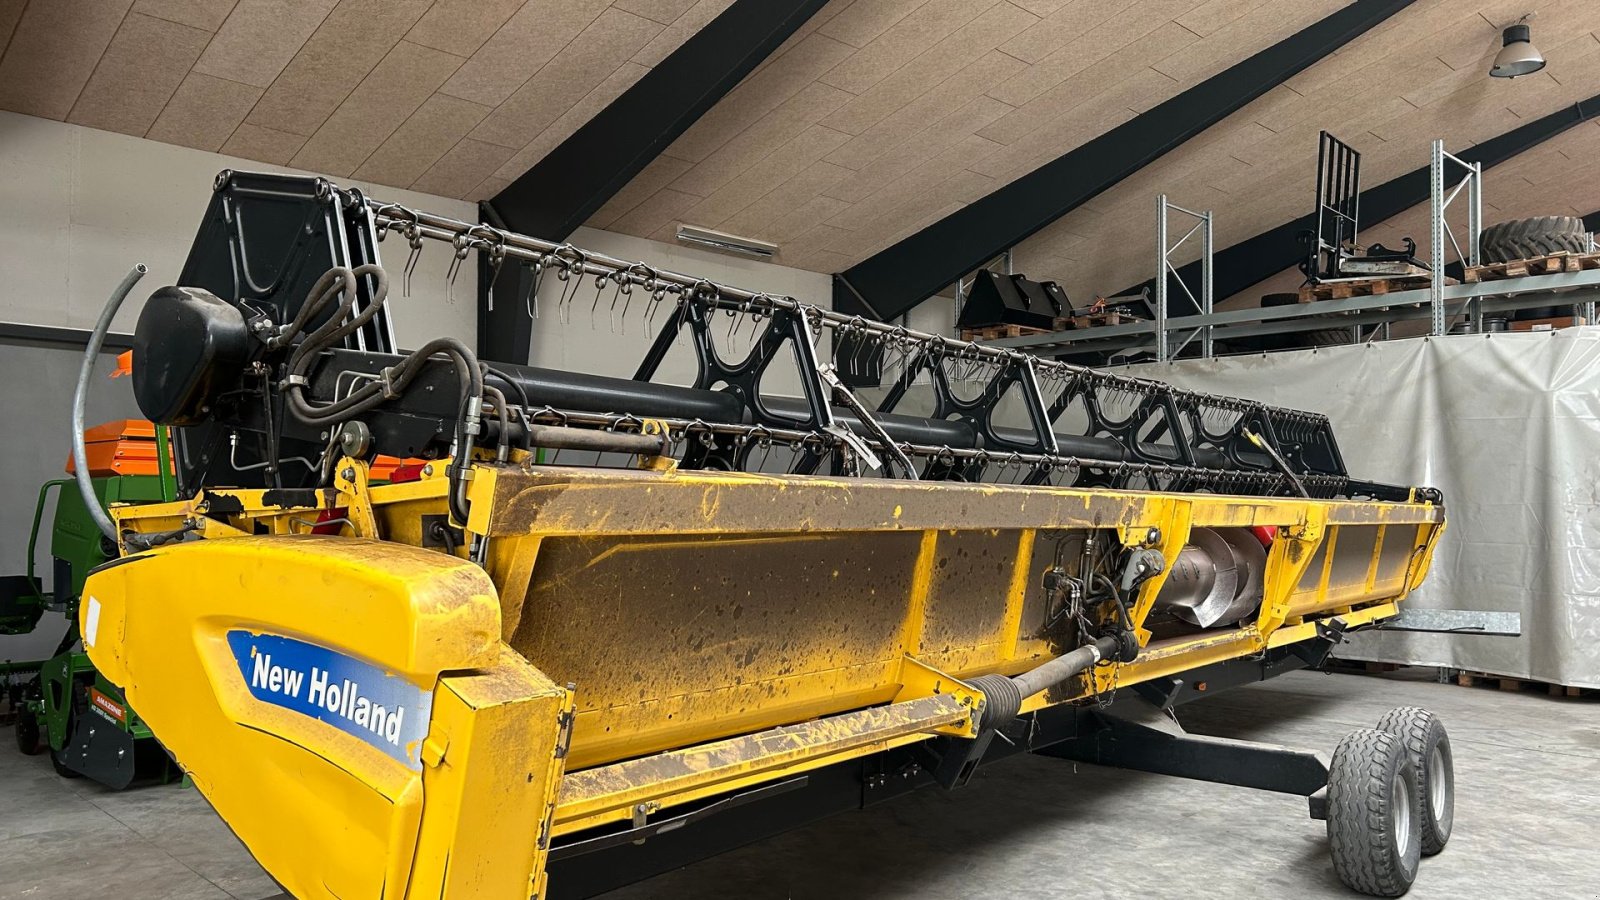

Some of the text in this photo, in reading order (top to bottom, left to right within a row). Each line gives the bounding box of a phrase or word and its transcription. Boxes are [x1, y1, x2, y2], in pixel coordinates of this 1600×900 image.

[96, 696, 122, 716] AMAZONE
[252, 653, 404, 745] New Holland
